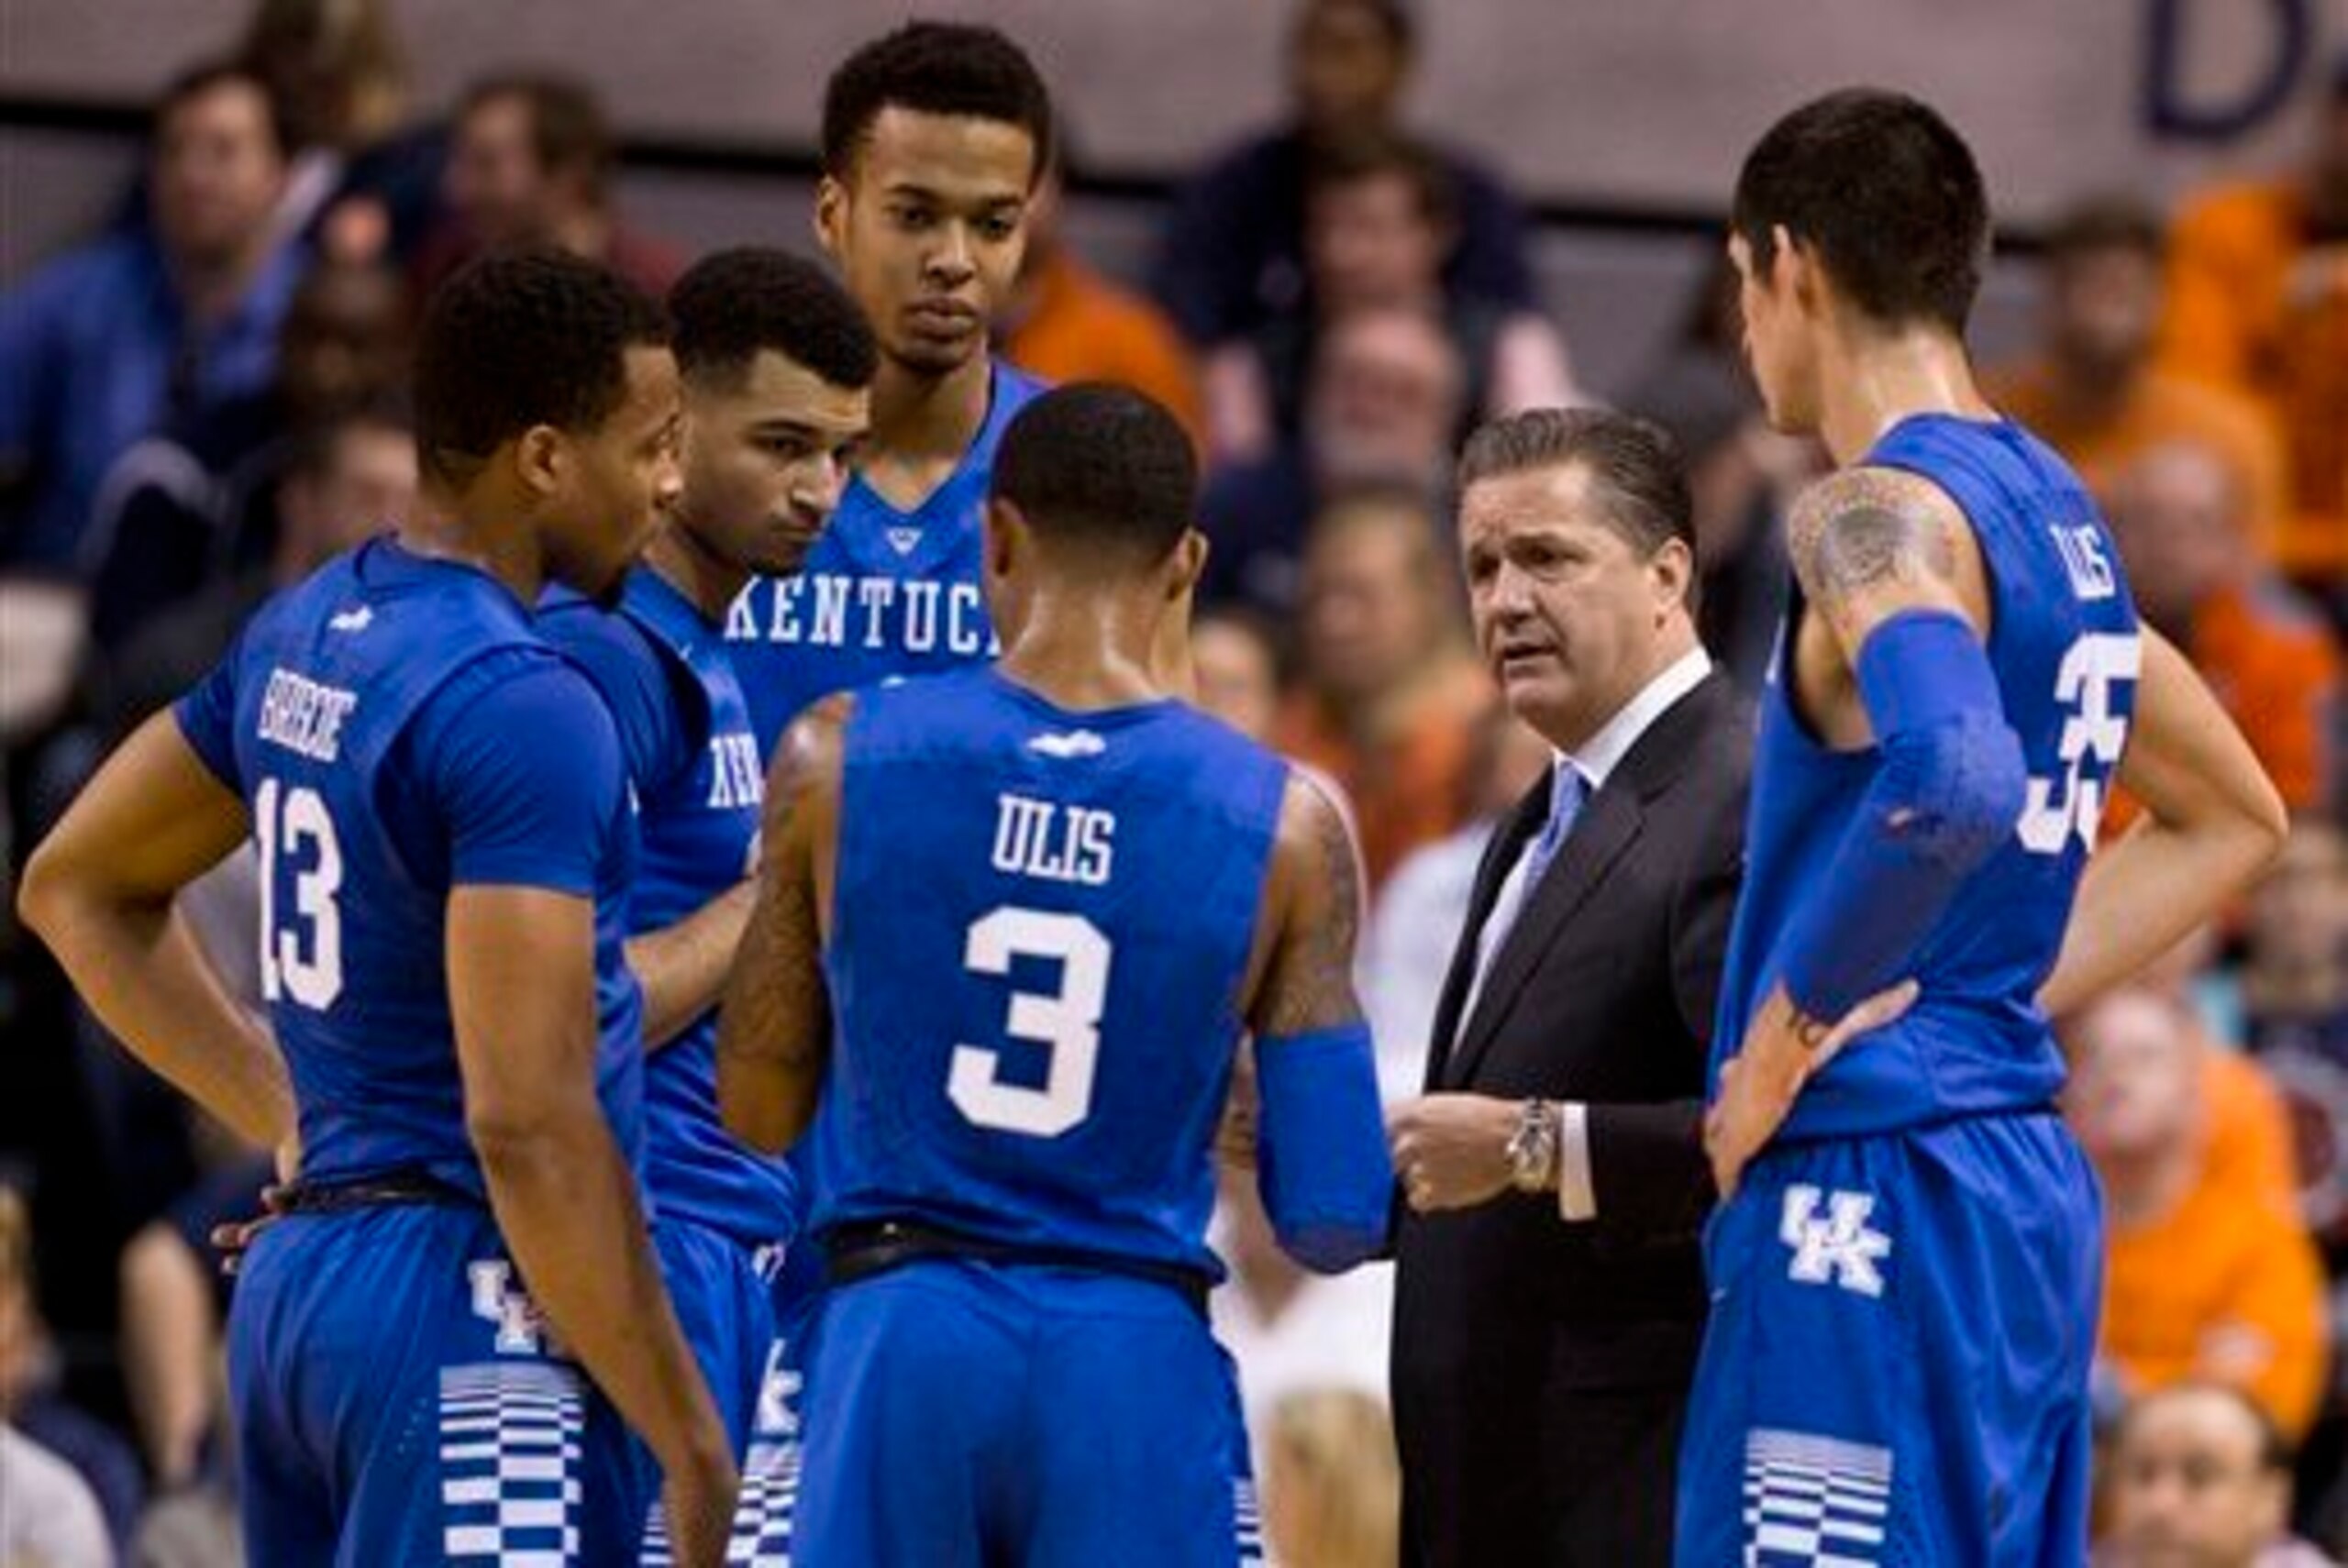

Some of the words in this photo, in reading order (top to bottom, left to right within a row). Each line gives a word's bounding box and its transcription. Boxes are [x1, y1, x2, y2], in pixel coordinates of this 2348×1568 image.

[991, 792, 1116, 885] ULIS
[2017, 631, 2142, 855] 35
[255, 778, 343, 1010] 13
[946, 904, 1113, 1138] 3
[1778, 1182, 1891, 1298] UK
